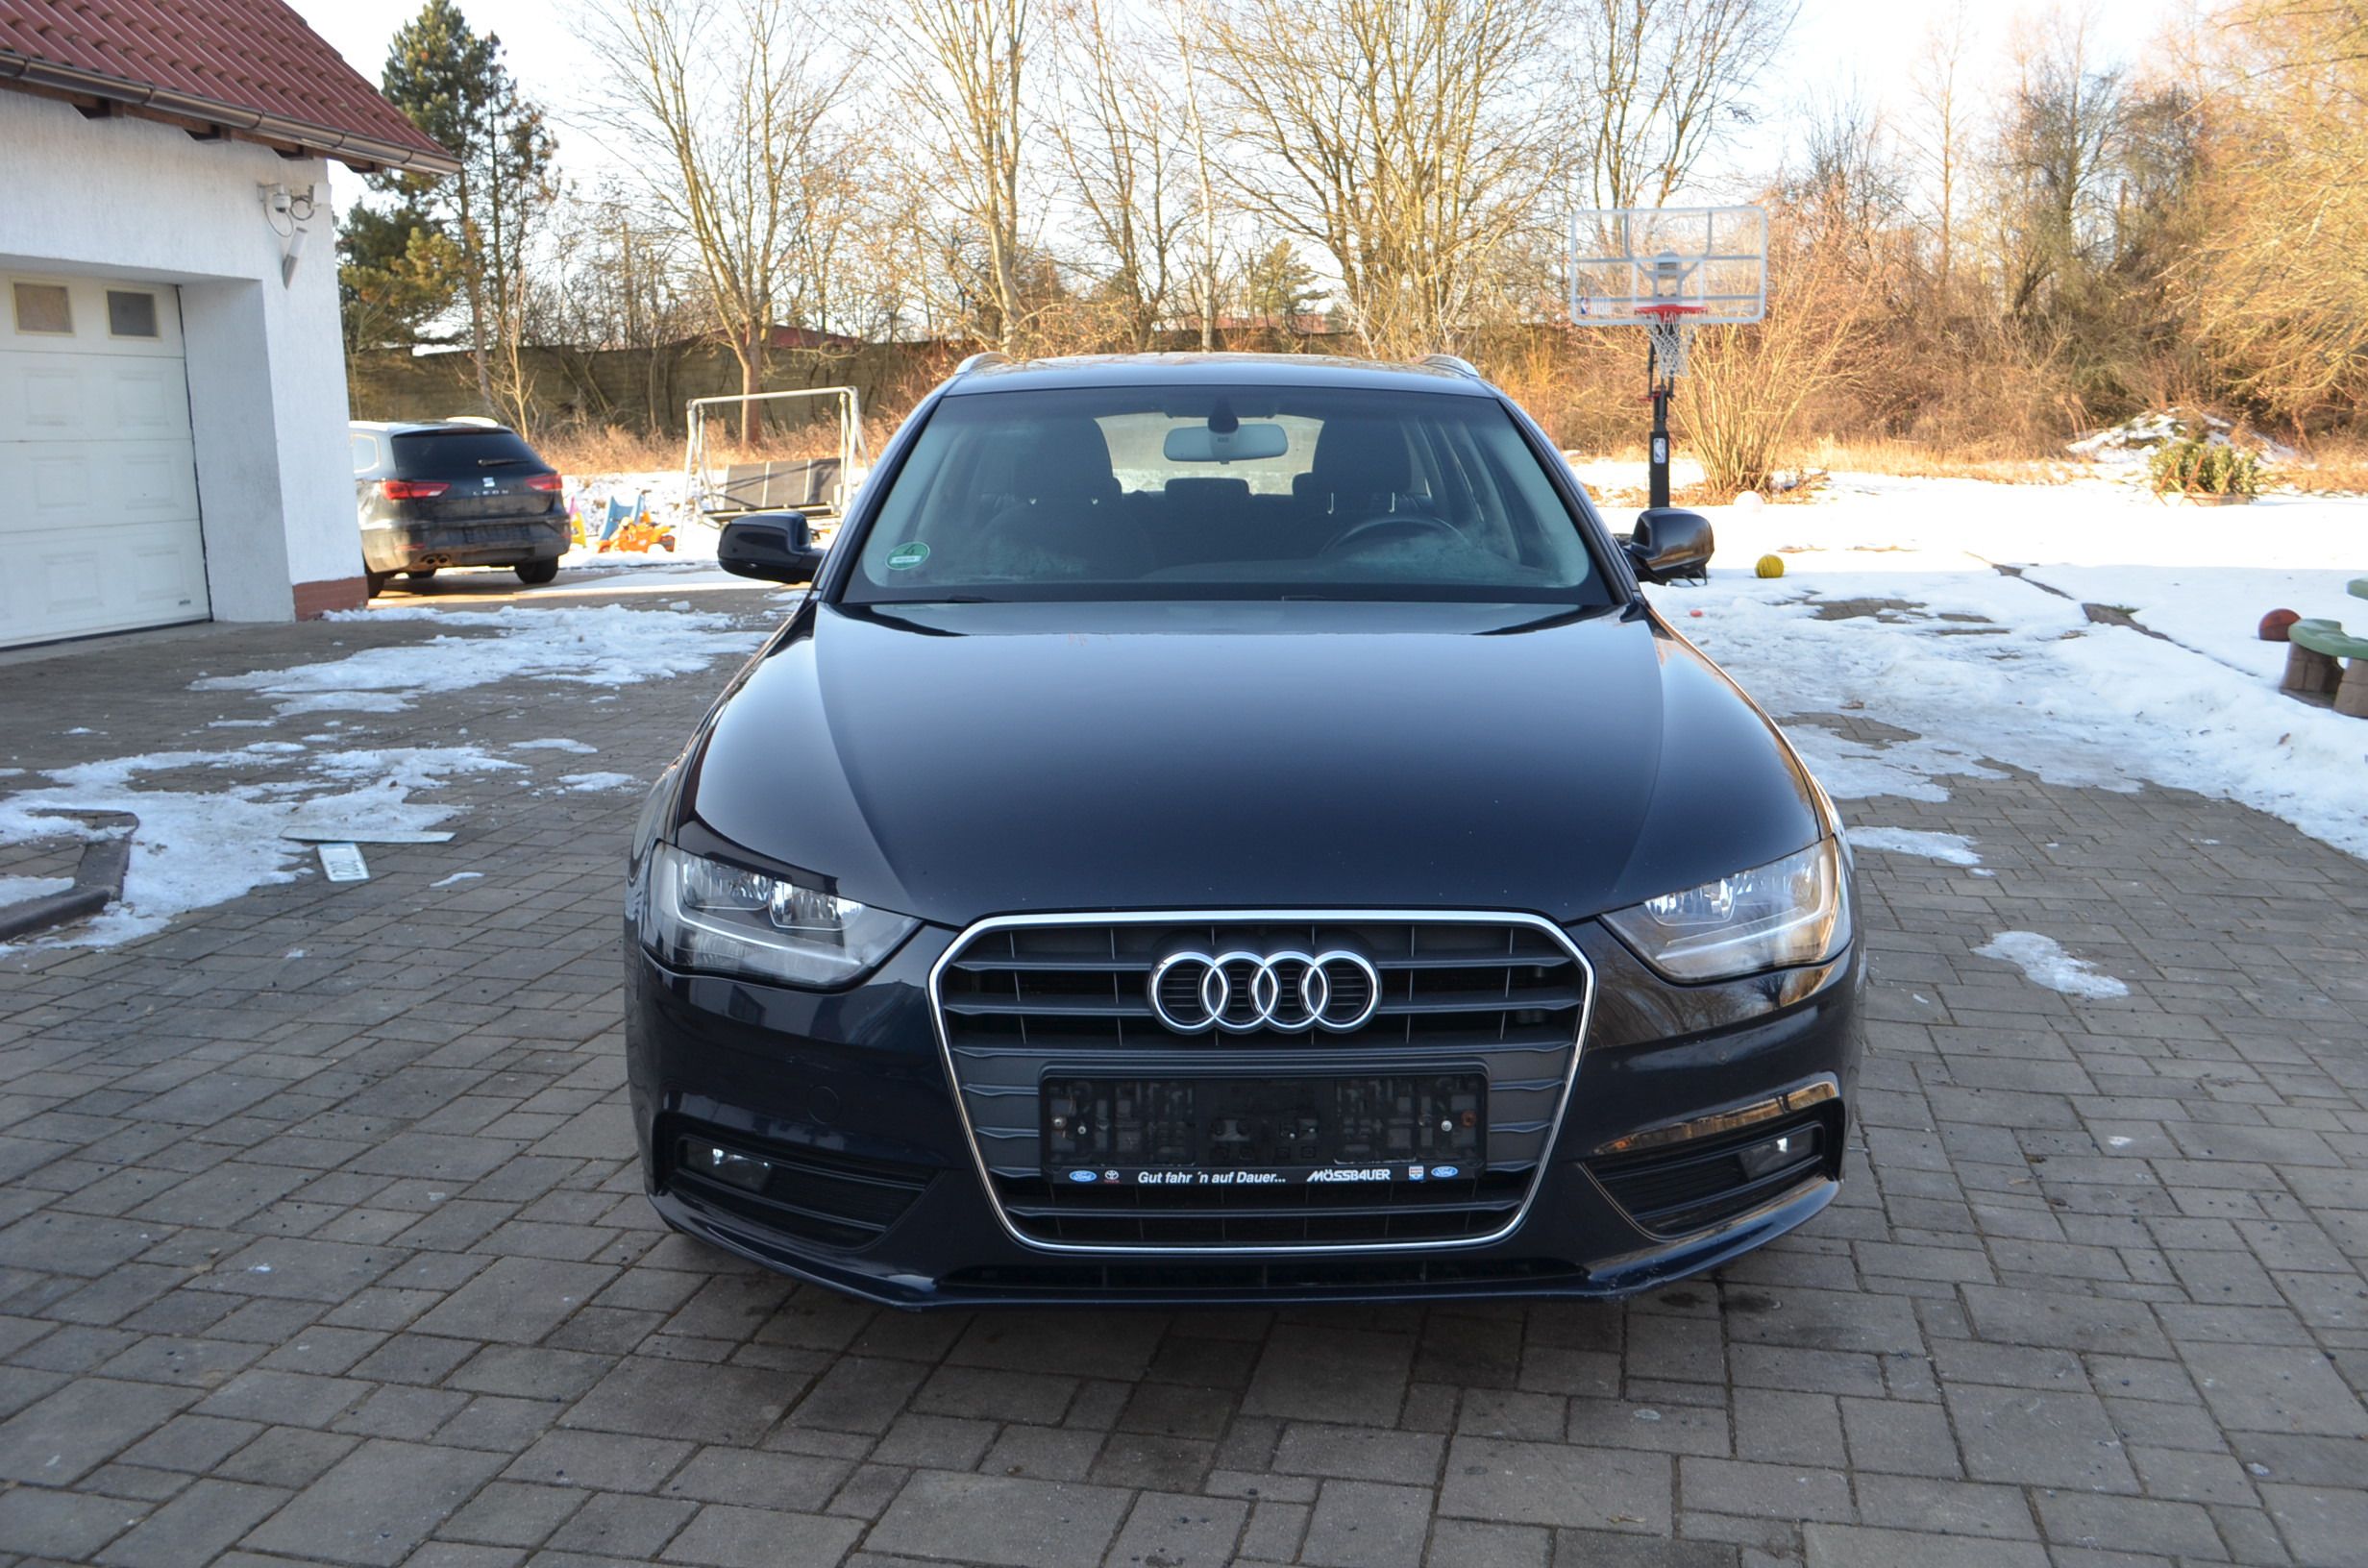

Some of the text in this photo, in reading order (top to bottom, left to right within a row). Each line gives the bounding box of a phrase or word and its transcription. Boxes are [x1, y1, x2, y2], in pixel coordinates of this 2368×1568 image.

[1137, 1171, 1163, 1184] Gut
[1164, 1171, 1193, 1184] fahr
[1211, 1171, 1235, 1184] auf
[1236, 1171, 1286, 1184] Dauer...
[1306, 1168, 1391, 1182] MÖSSBAUER
